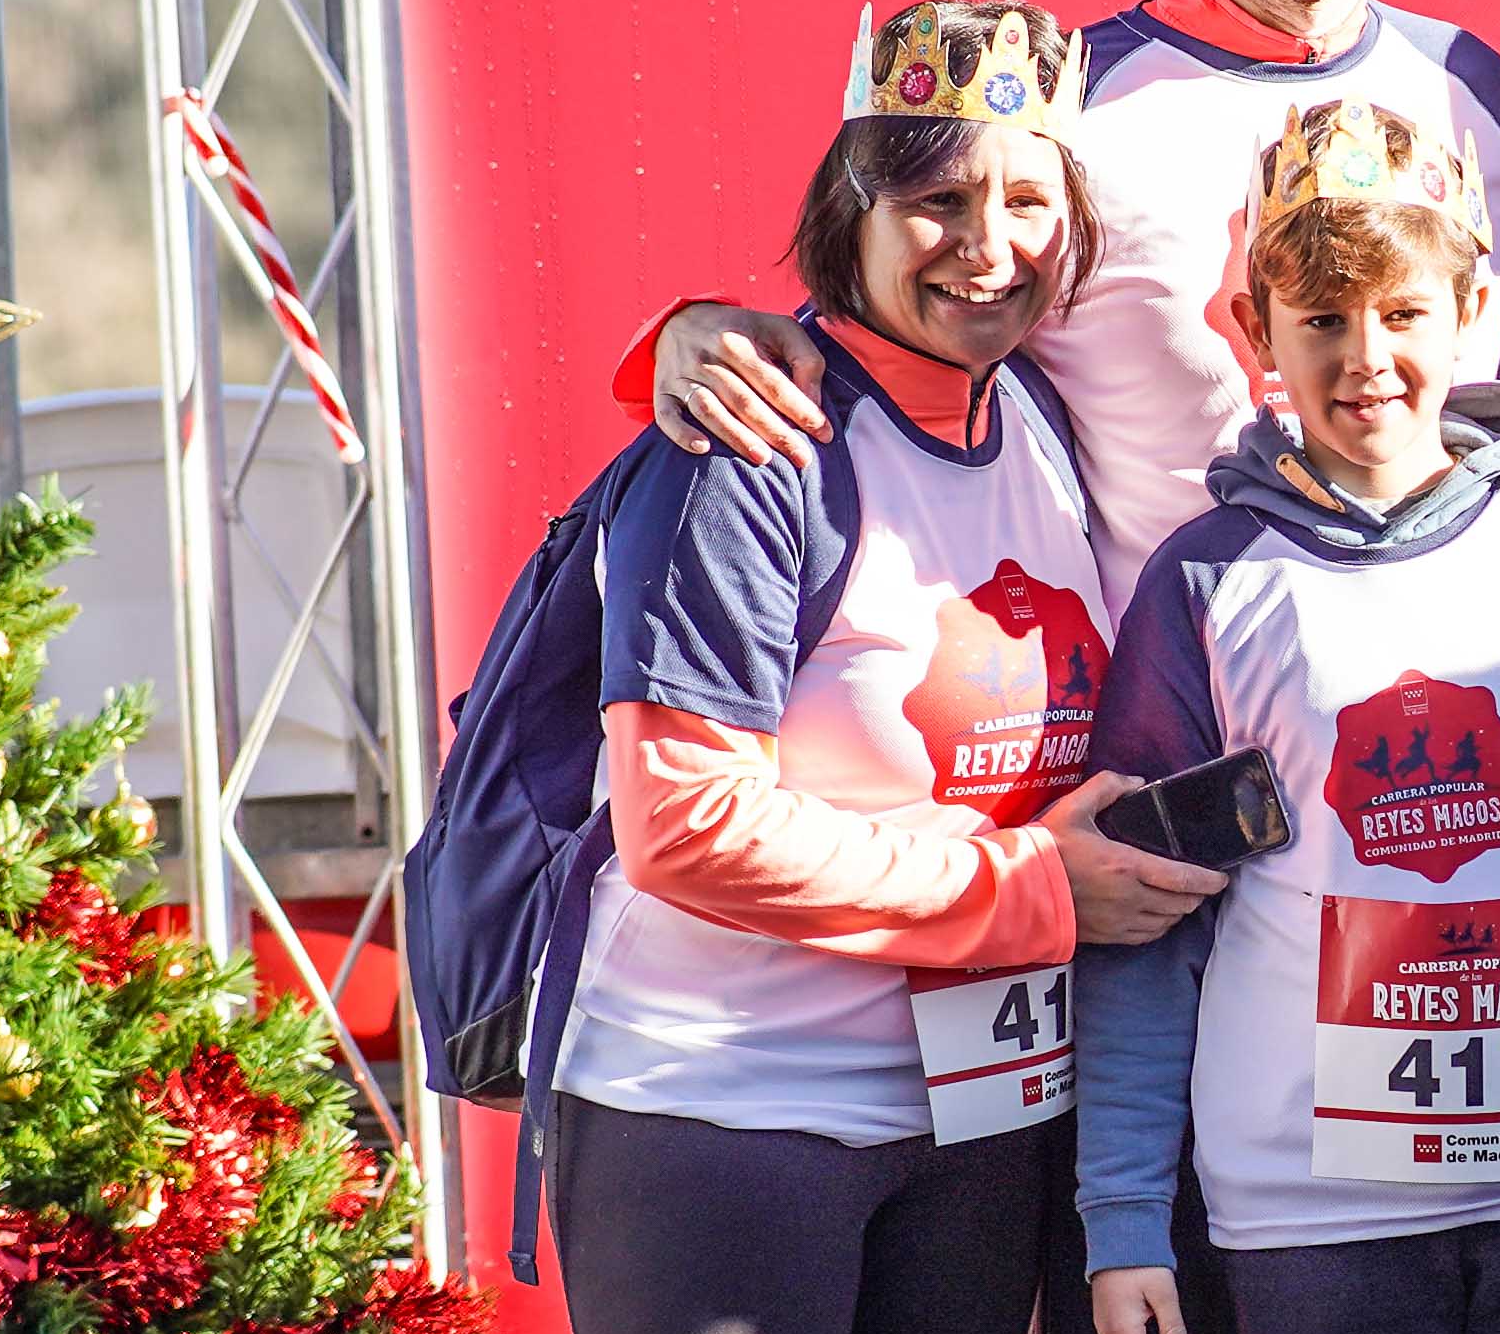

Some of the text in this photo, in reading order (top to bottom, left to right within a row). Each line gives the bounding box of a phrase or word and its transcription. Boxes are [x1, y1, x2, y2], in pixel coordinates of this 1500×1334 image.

[973, 711, 1043, 735] CARRERA
[1045, 710, 1094, 722] POPULAR
[952, 733, 1090, 779] REYES MAGO
[1031, 777, 1047, 788] DE
[1371, 782, 1485, 806] CARRERA POPULAR
[1362, 807, 1425, 842] REYES
[1365, 840, 1437, 858] COMUNIDAD
[1441, 835, 1456, 847] DE
[1398, 959, 1469, 974] CARRERA
[992, 970, 1067, 1052] 41
[1372, 981, 1460, 1023] REYES
[1045, 1086, 1057, 1100] de
[1446, 1151, 1468, 1163] de
